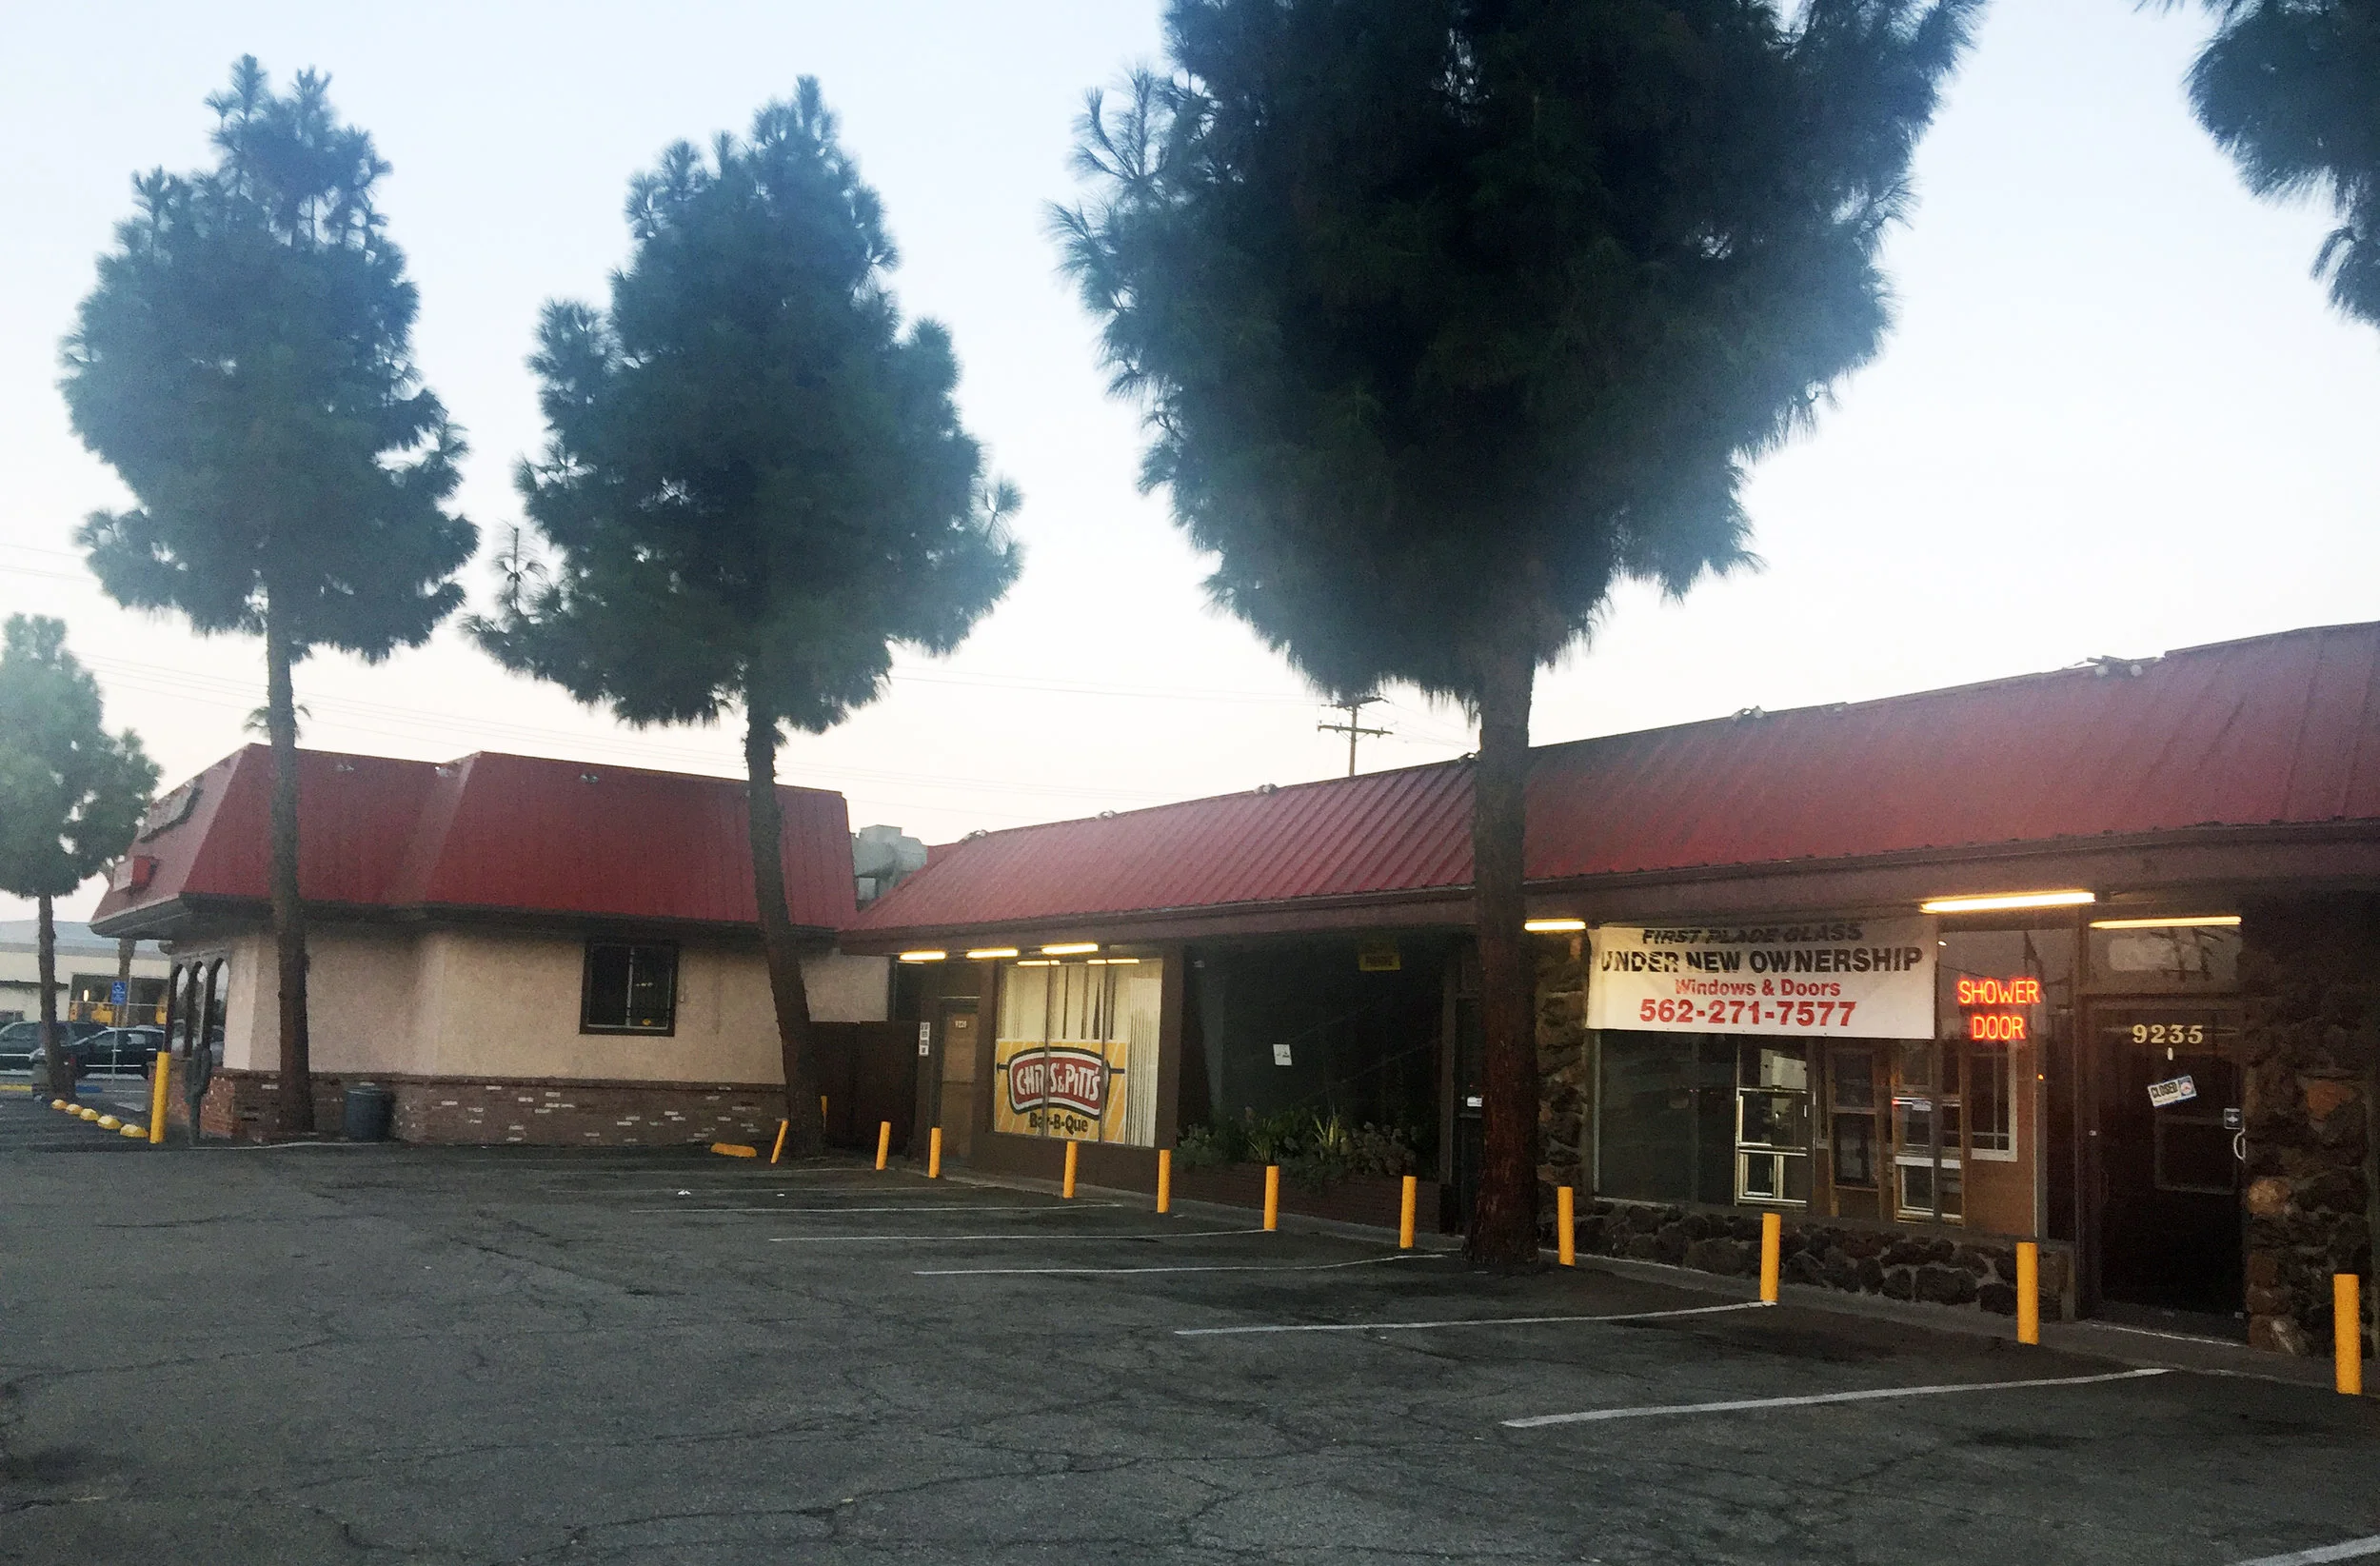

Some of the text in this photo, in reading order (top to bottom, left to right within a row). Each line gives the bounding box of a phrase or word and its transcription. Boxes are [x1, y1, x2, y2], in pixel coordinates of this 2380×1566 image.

[1641, 922, 1864, 945] FIRST PLACE GLASS
[1601, 946, 1923, 974] UNDER NEW OWNERSHIP
[1676, 979, 1840, 998] Windows & Doors
[1957, 978, 2040, 1004] SHOWER
[1639, 999, 1856, 1026] 562-271-7577
[1972, 1016, 2026, 1041] DOOR
[2132, 1023, 2204, 1044] 9235
[1016, 1062, 1060, 1096] CHRS'
[1029, 1112, 1088, 1136] Ba-B-Que
